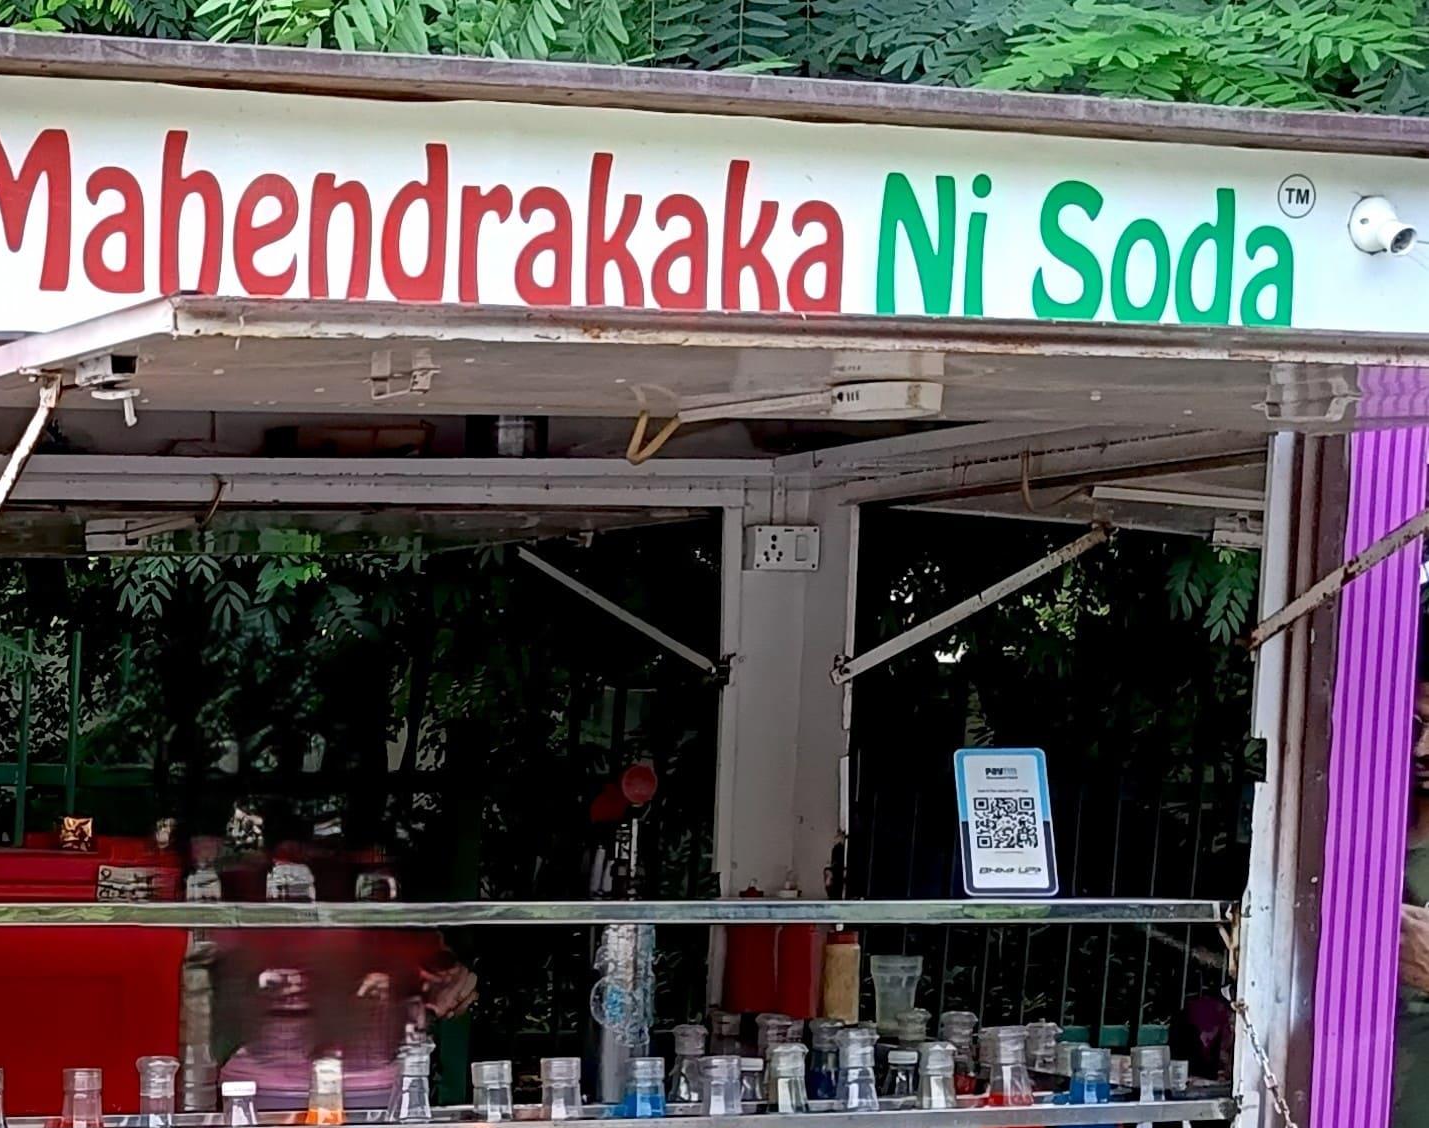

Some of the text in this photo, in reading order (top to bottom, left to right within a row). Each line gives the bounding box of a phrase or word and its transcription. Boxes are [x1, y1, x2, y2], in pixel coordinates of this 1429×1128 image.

[876, 171, 993, 318] Ni
[1032, 179, 1296, 327] Soda
[1284, 188, 1310, 205] TM
